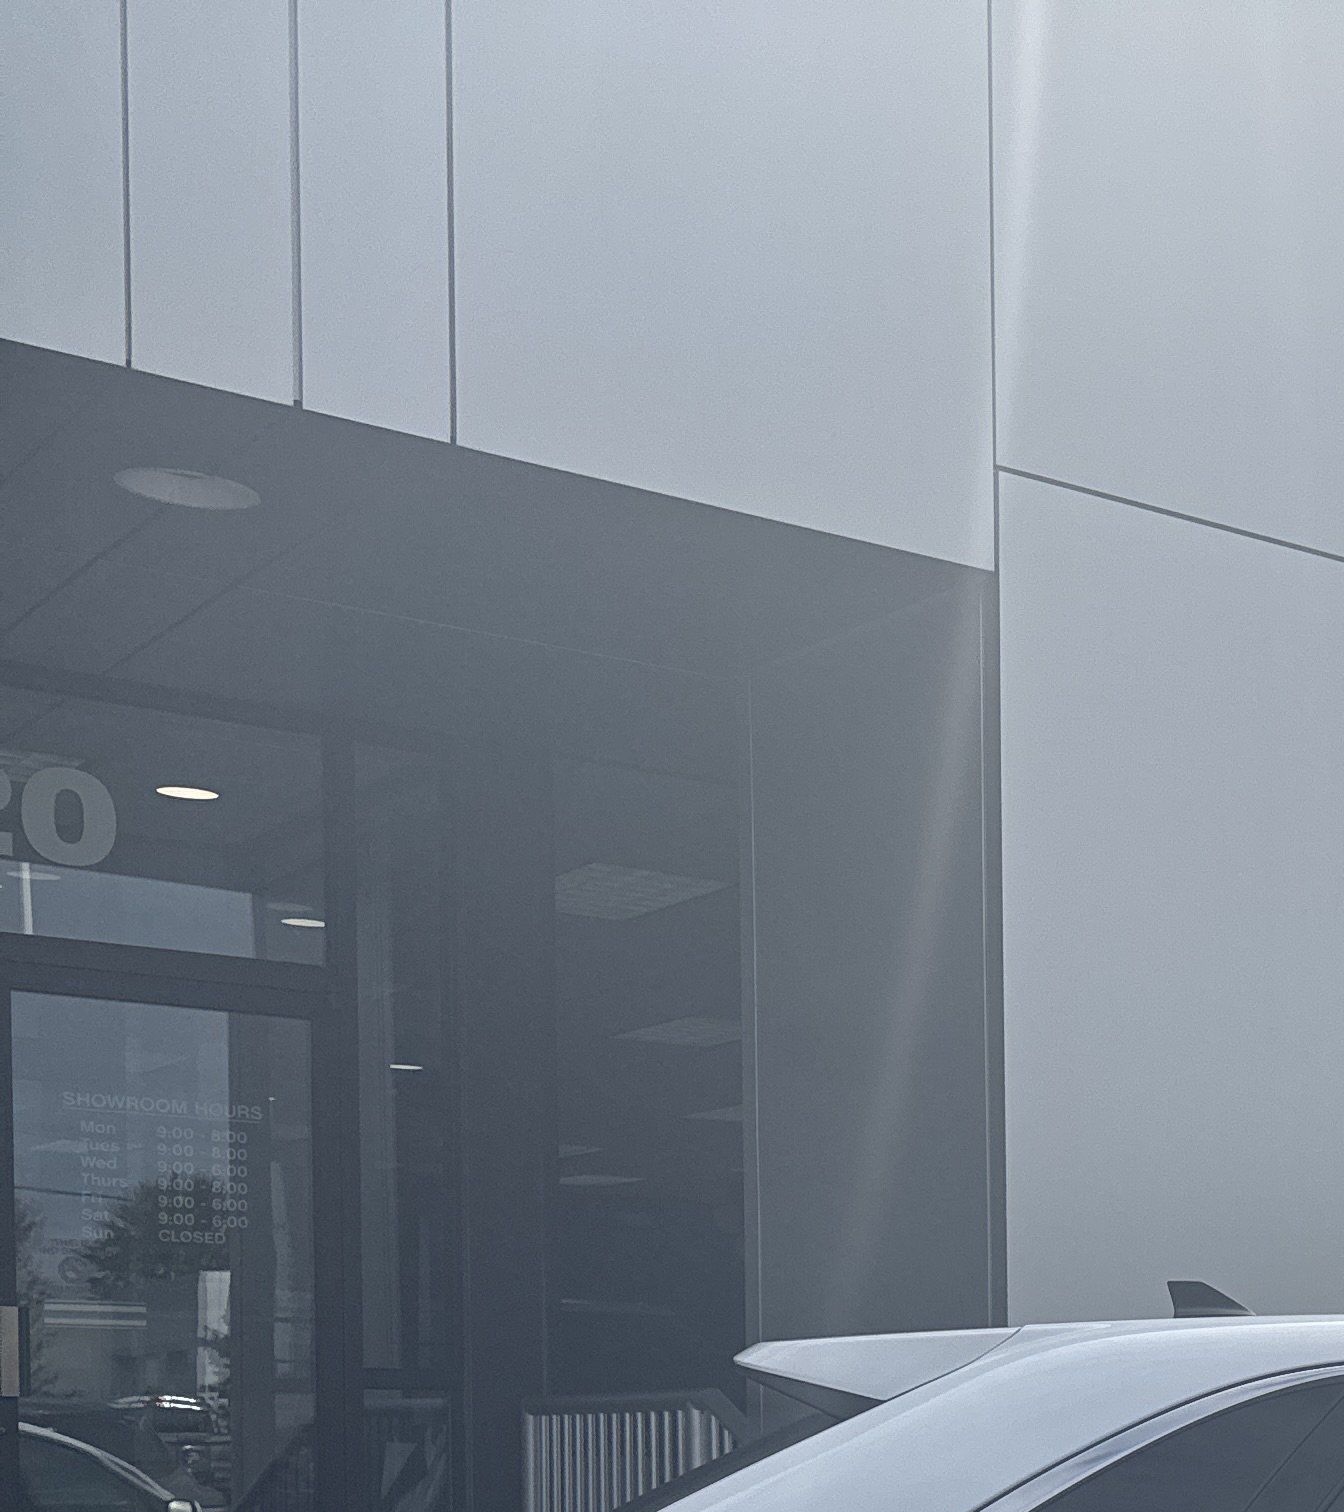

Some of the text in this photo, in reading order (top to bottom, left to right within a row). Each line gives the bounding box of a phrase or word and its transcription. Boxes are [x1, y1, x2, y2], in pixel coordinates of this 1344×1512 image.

[0, 765, 117, 867] 0
[62, 1091, 264, 1120] SHOWROOM HOURS
[80, 1120, 117, 1134] Mon
[155, 1126, 194, 1139] 9:00
[211, 1129, 247, 1144] 8:00
[156, 1143, 194, 1157] 9:00
[211, 1147, 247, 1161] 8:00
[80, 1156, 117, 1169] Wed
[157, 1161, 195, 1174] 9:00
[211, 1164, 247, 1178] 6:00
[81, 1173, 129, 1188] Thurs
[158, 1178, 195, 1191] 9:00
[211, 1181, 248, 1195] 8:00
[158, 1195, 195, 1208] 9:00
[212, 1198, 248, 1211] 6:00
[81, 1208, 110, 1221] Sat
[158, 1212, 195, 1225] 9:00
[212, 1216, 249, 1229] 6:00
[81, 1225, 226, 1244] Sun CLOSED
